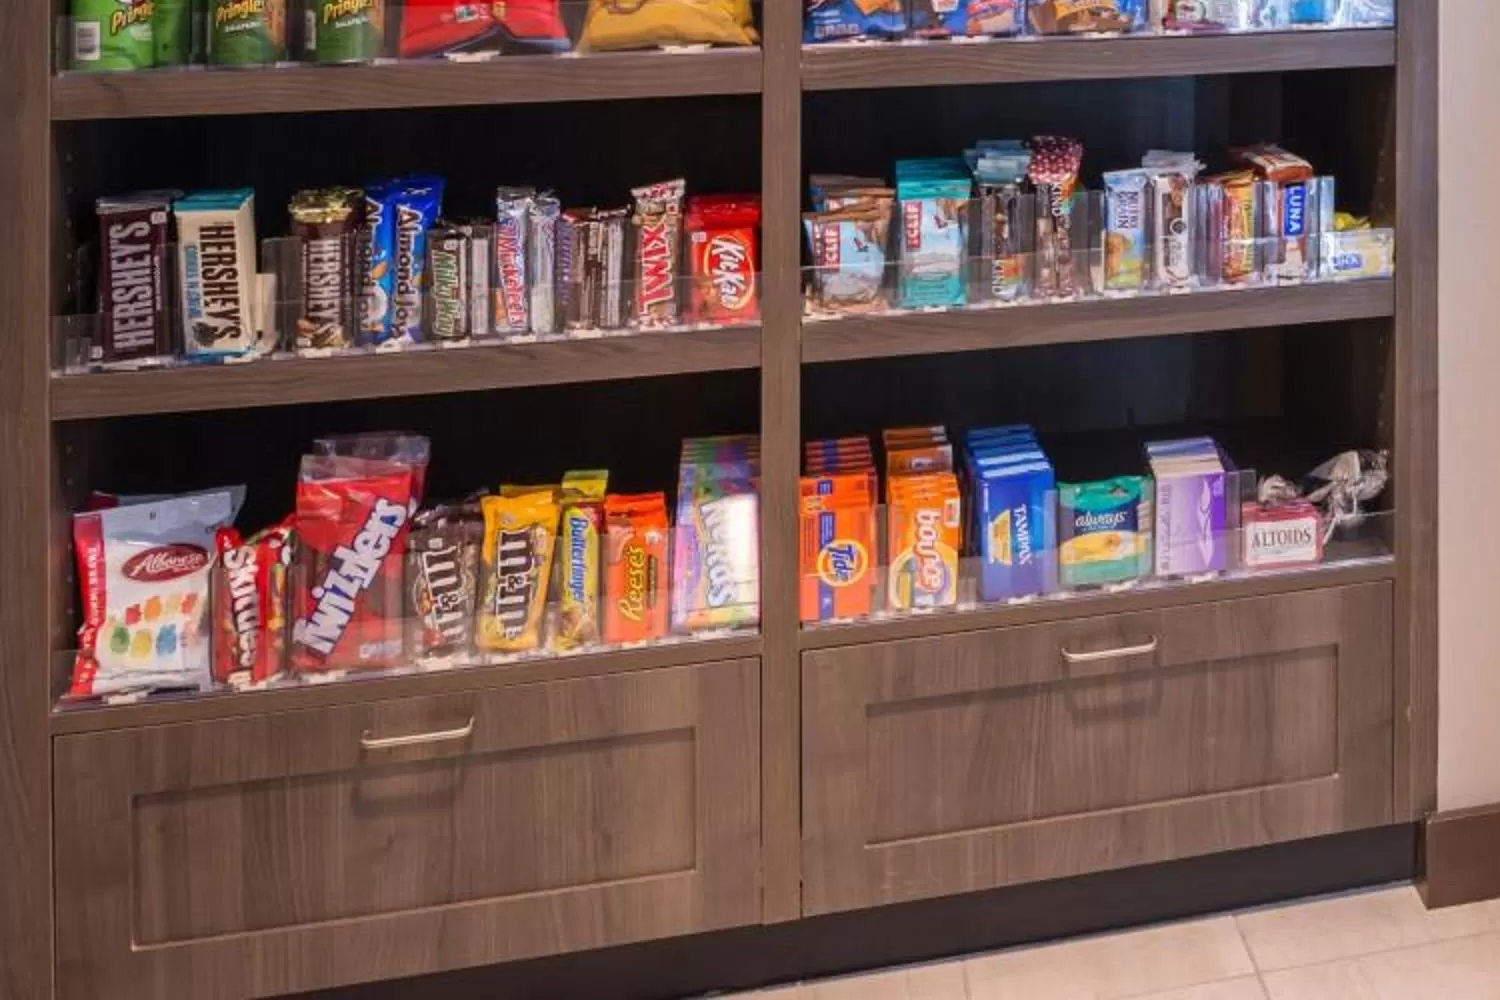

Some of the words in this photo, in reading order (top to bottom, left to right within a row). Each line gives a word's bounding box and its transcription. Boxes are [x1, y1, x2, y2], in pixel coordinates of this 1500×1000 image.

[907, 203, 920, 237] CLIF
[1051, 181, 1064, 217] KIND
[1287, 185, 1303, 232] LUNA
[396, 205, 422, 294] Almond
[640, 223, 674, 320] TWIX
[991, 260, 1004, 297] KIND
[109, 220, 155, 349] HERSHEY'S
[200, 221, 241, 342] HERSHEY'S
[914, 509, 945, 592] bounce
[1012, 503, 1033, 566] TAMPAX
[1075, 510, 1127, 529] always
[1252, 528, 1312, 547] ALTOIDS
[569, 516, 589, 603] Butterfinger
[618, 546, 647, 622] Reese's
[828, 545, 856, 582] Tide
